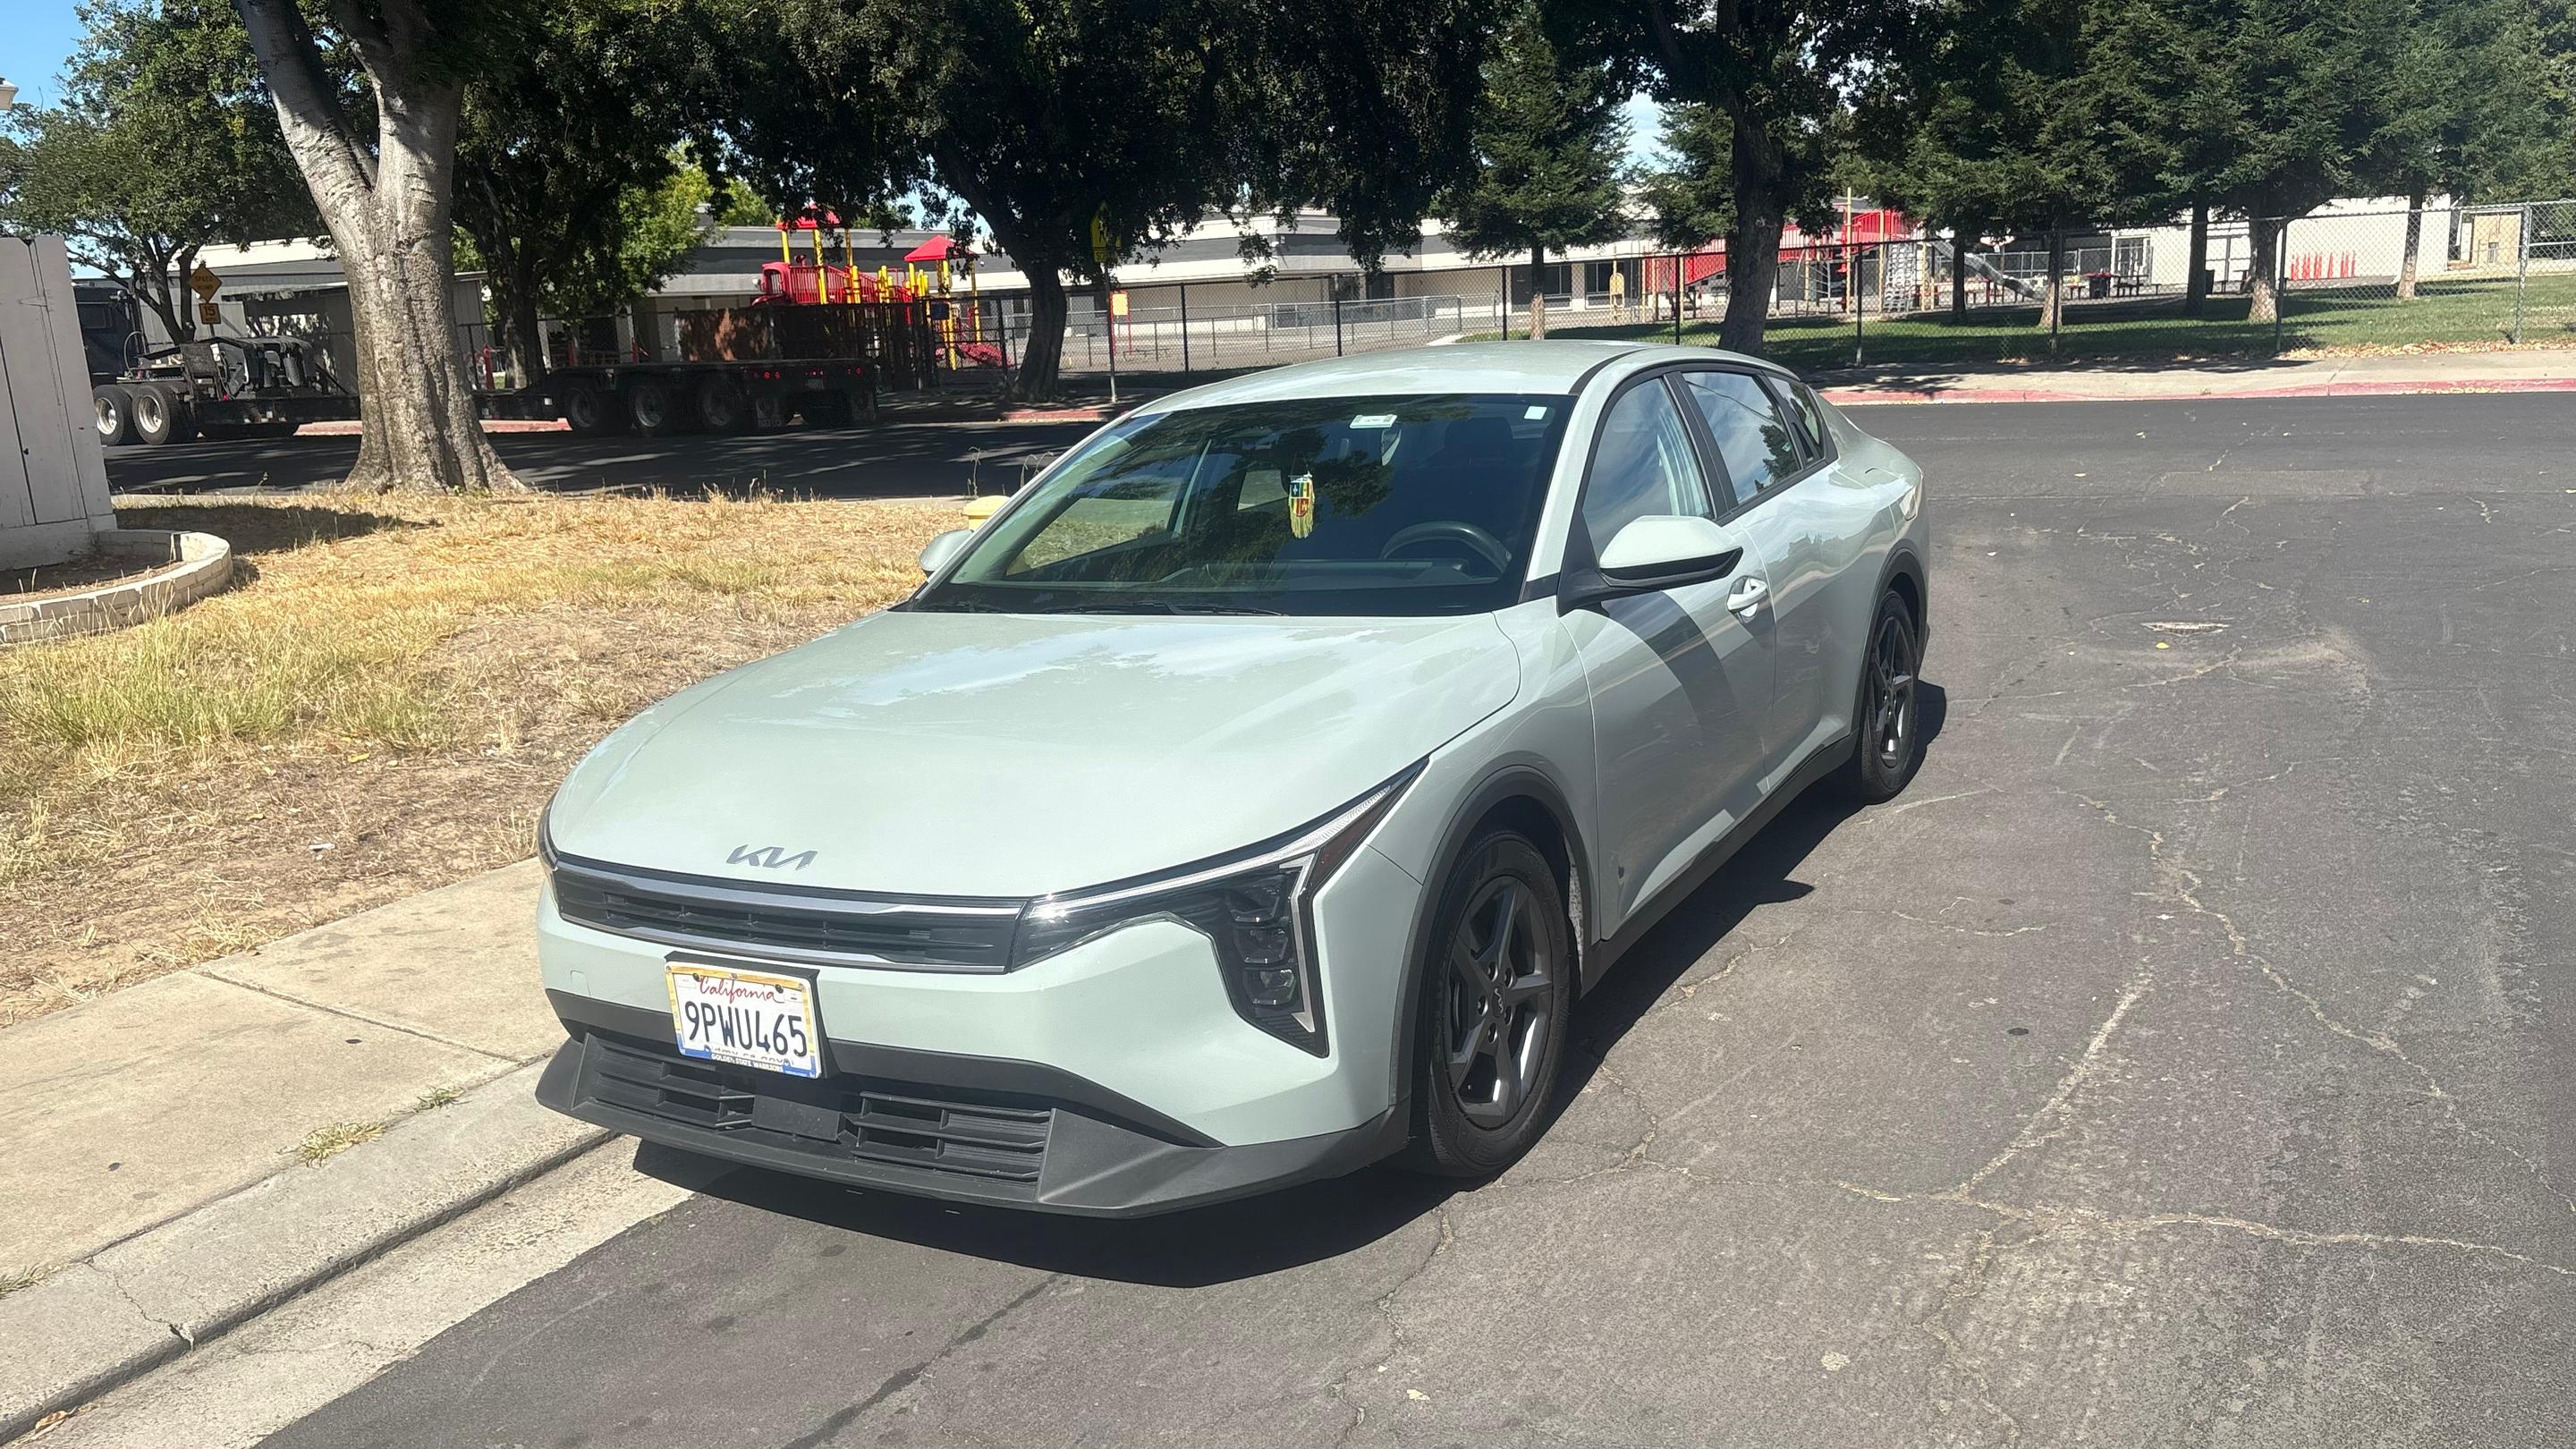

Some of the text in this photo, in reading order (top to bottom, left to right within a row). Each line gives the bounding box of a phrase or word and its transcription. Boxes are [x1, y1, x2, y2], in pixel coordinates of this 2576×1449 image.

[203, 305, 216, 316] 15
[726, 844, 818, 870] KIA
[699, 975, 785, 1004] California
[684, 1000, 808, 1057] 9PWU465
